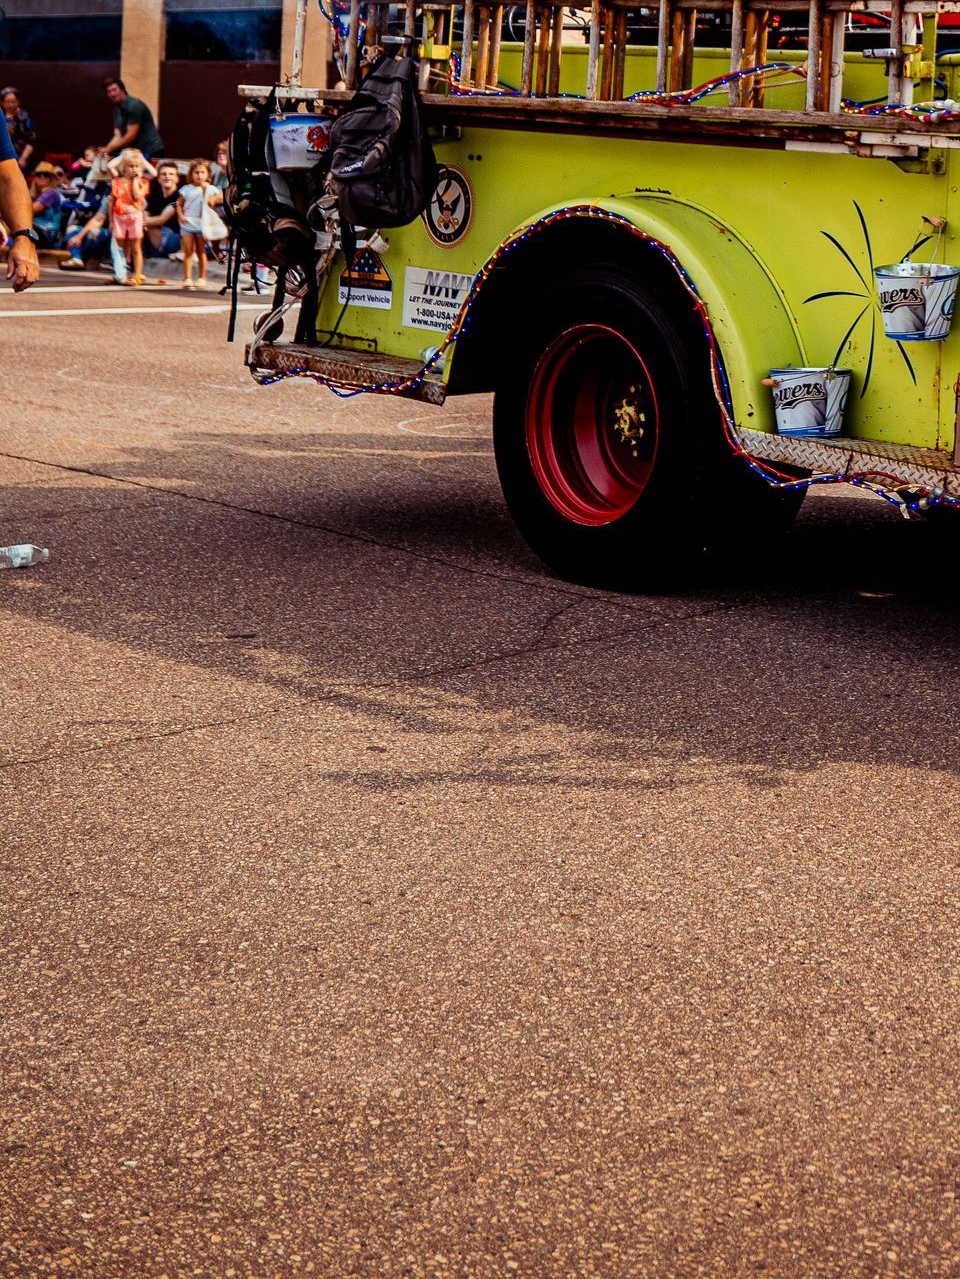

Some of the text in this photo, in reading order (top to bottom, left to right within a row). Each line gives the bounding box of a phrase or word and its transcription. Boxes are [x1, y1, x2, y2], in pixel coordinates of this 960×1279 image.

[366, 294, 391, 304] Vehicle
[409, 295, 462, 309] LET THE JOURNEY
